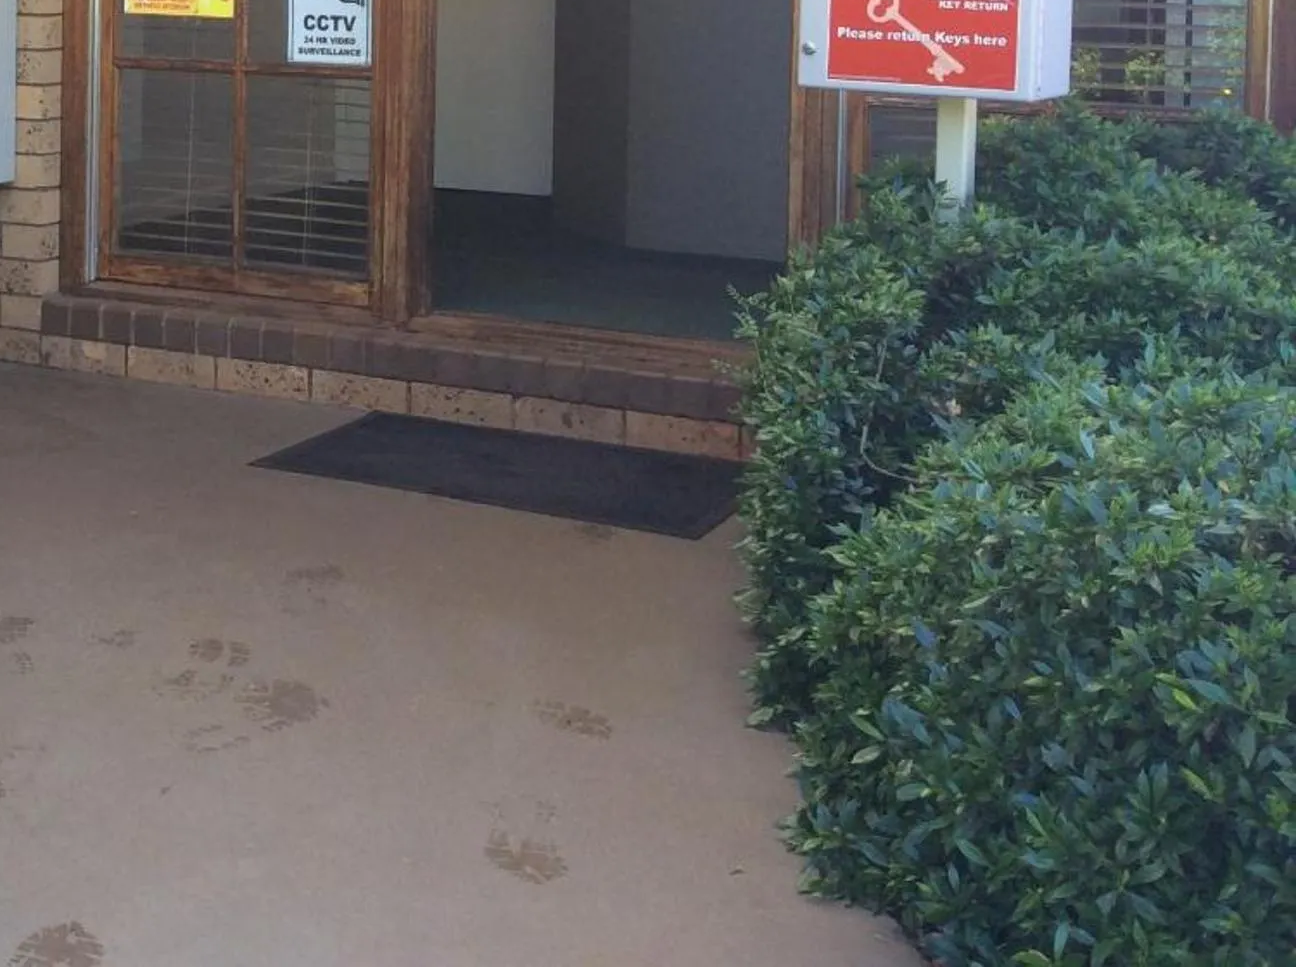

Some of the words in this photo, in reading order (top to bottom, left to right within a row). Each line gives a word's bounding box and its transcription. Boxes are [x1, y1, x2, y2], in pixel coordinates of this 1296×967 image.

[938, 0, 961, 9] KEY
[963, 0, 1009, 12] RETURN
[303, 14, 357, 32] CCTV
[303, 36, 314, 45] 24
[315, 36, 327, 45] HR
[329, 36, 356, 46] VIDEO
[837, 27, 884, 40] Please
[887, 30, 931, 42] return
[934, 31, 971, 46] Keys
[974, 33, 1008, 47] here
[298, 47, 362, 58] SURVEILLANCE
